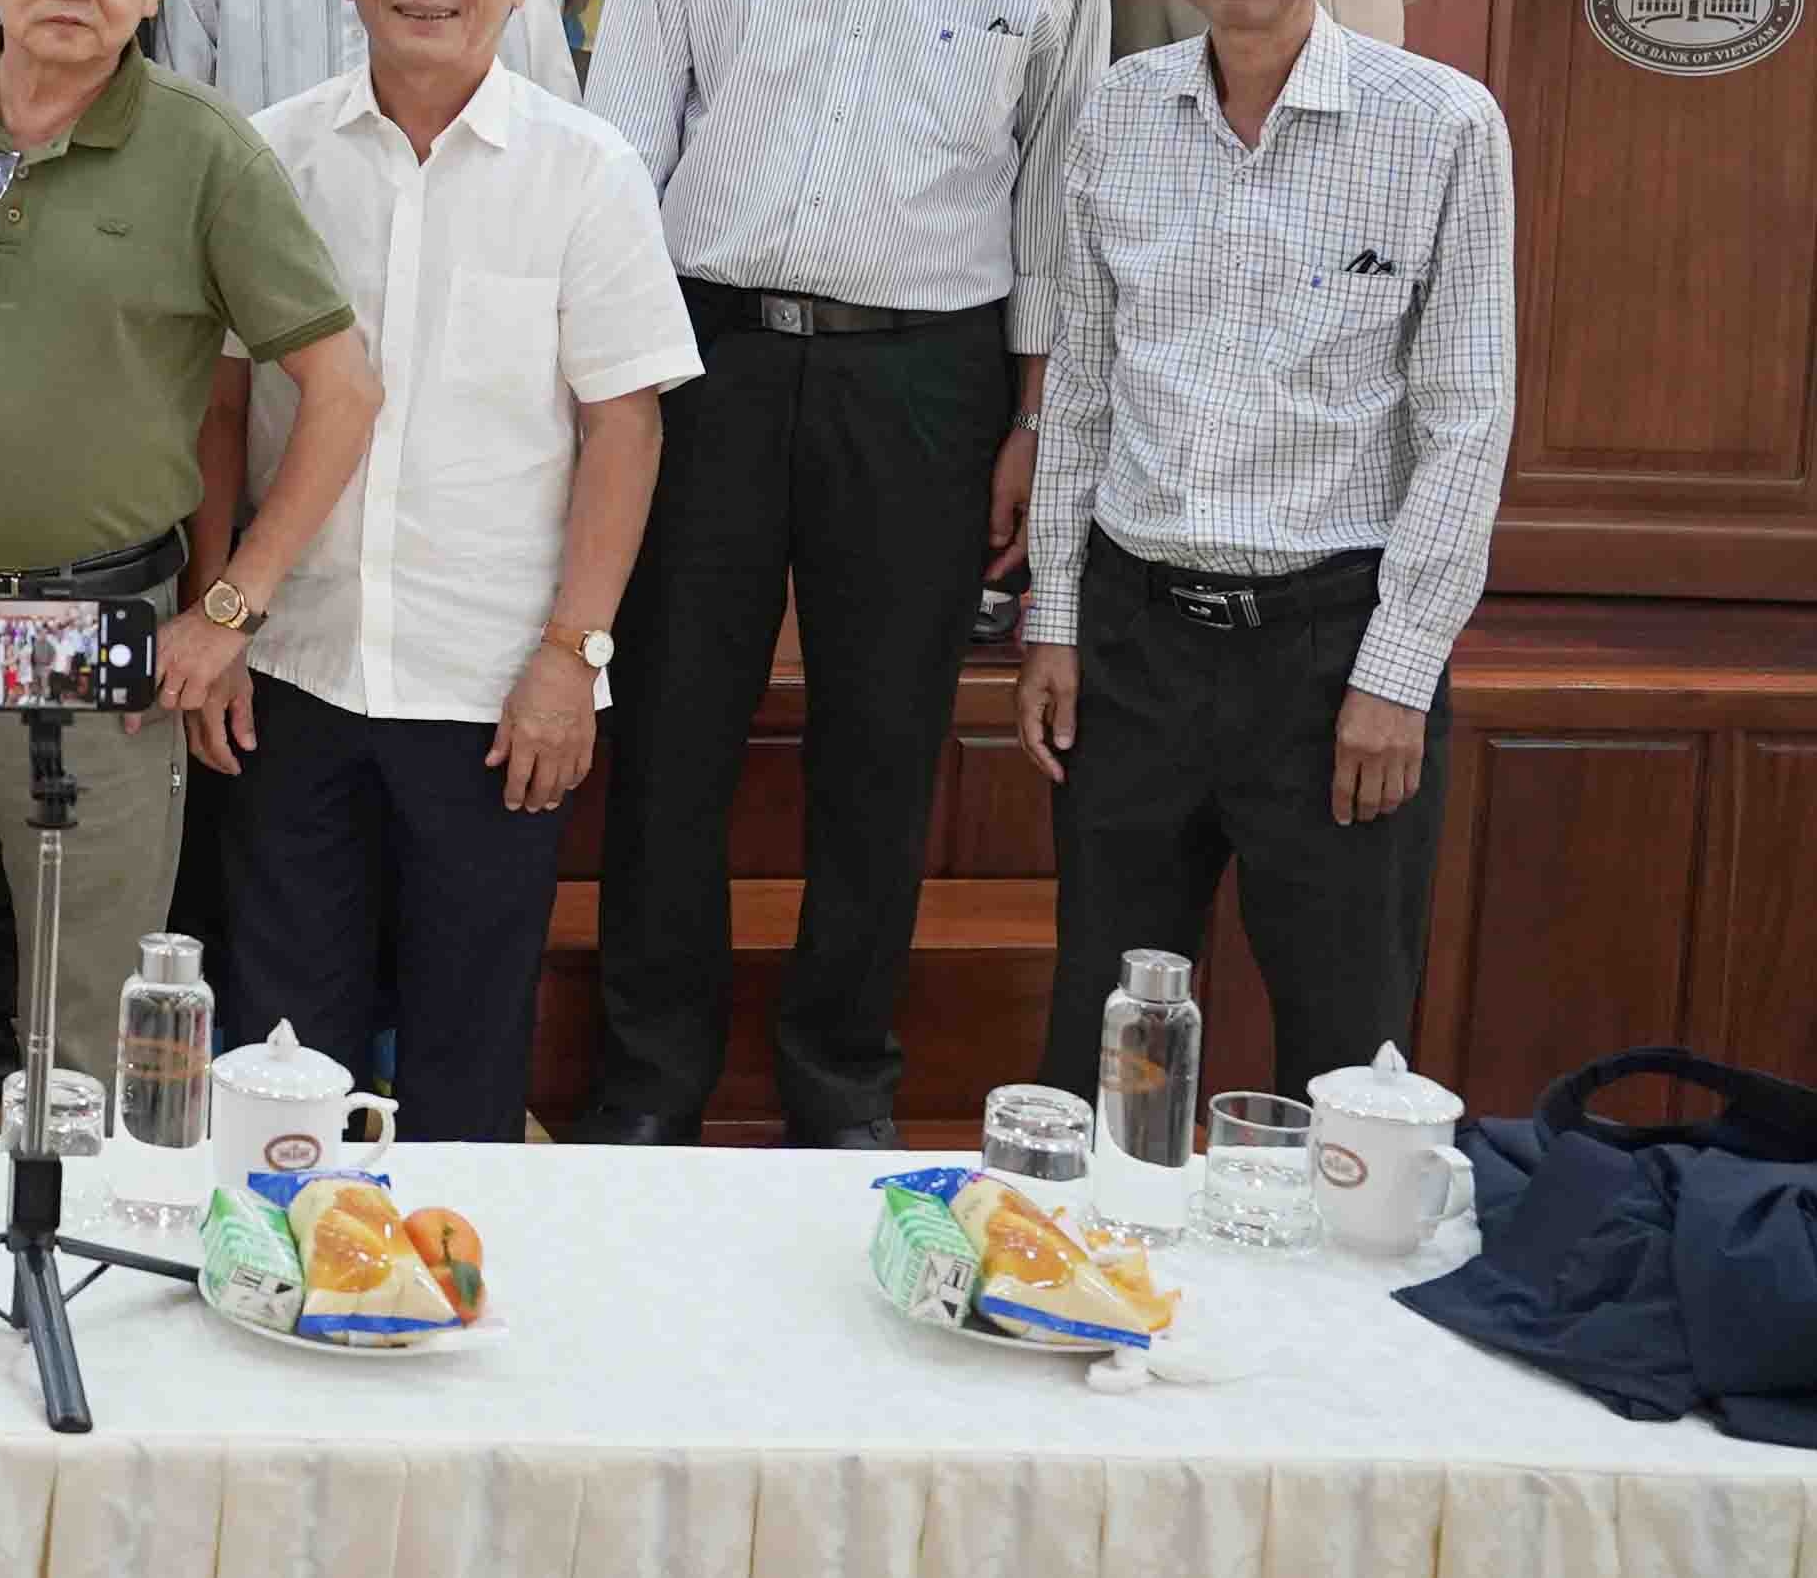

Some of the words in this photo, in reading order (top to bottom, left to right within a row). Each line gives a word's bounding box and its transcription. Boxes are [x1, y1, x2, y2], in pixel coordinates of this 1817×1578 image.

[1608, 22, 1649, 54] STATE
[1650, 48, 1690, 64] BANK
[1692, 52, 1711, 64] OF
[1714, 25, 1780, 63] VIETNAM
